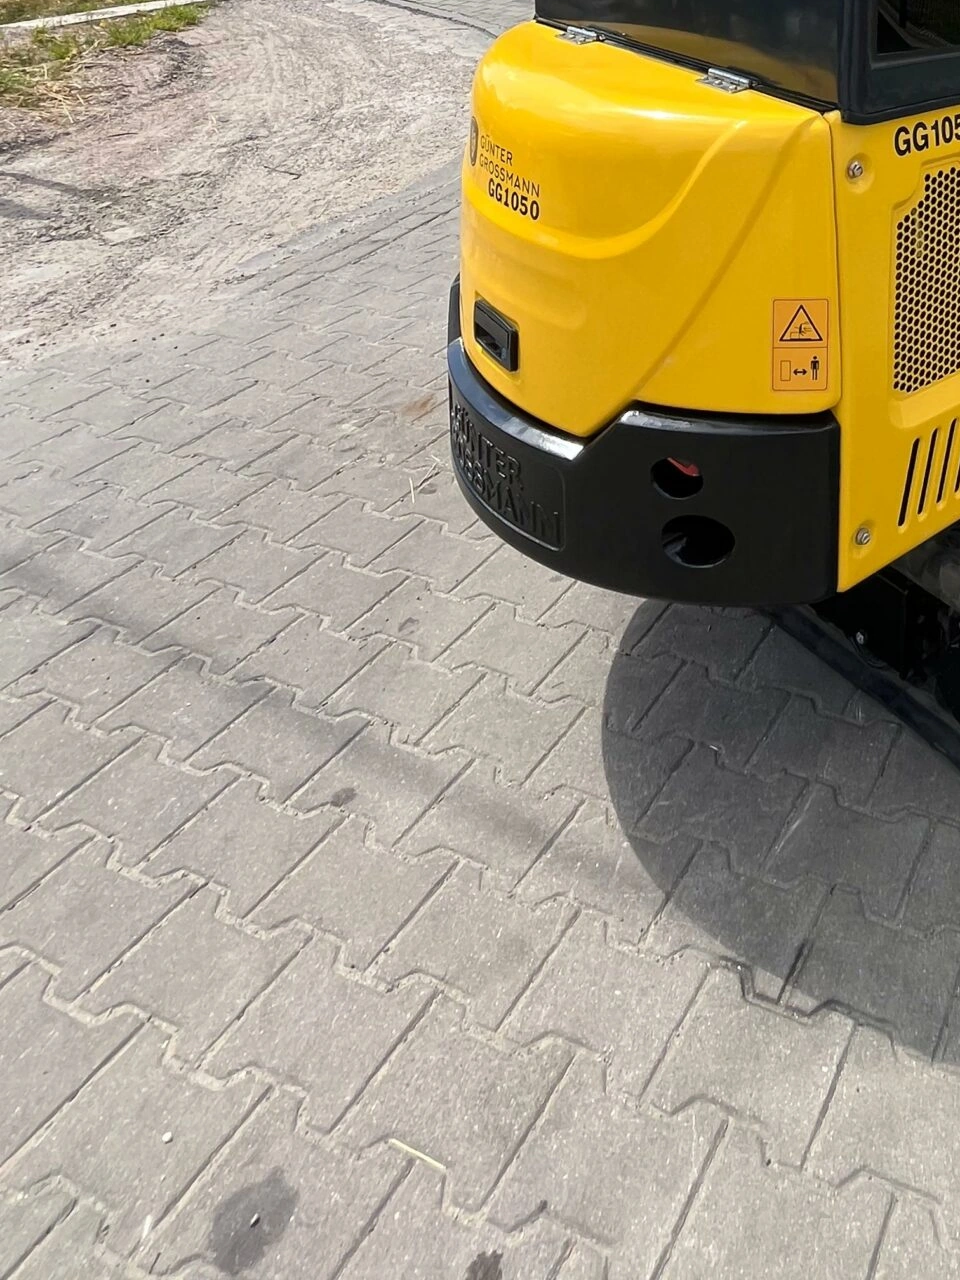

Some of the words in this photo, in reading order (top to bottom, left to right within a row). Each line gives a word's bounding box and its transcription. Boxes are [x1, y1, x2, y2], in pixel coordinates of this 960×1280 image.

[480, 134, 513, 167] GÜNTER
[479, 152, 540, 198] GROSSMANN
[488, 177, 540, 221] GG1050
